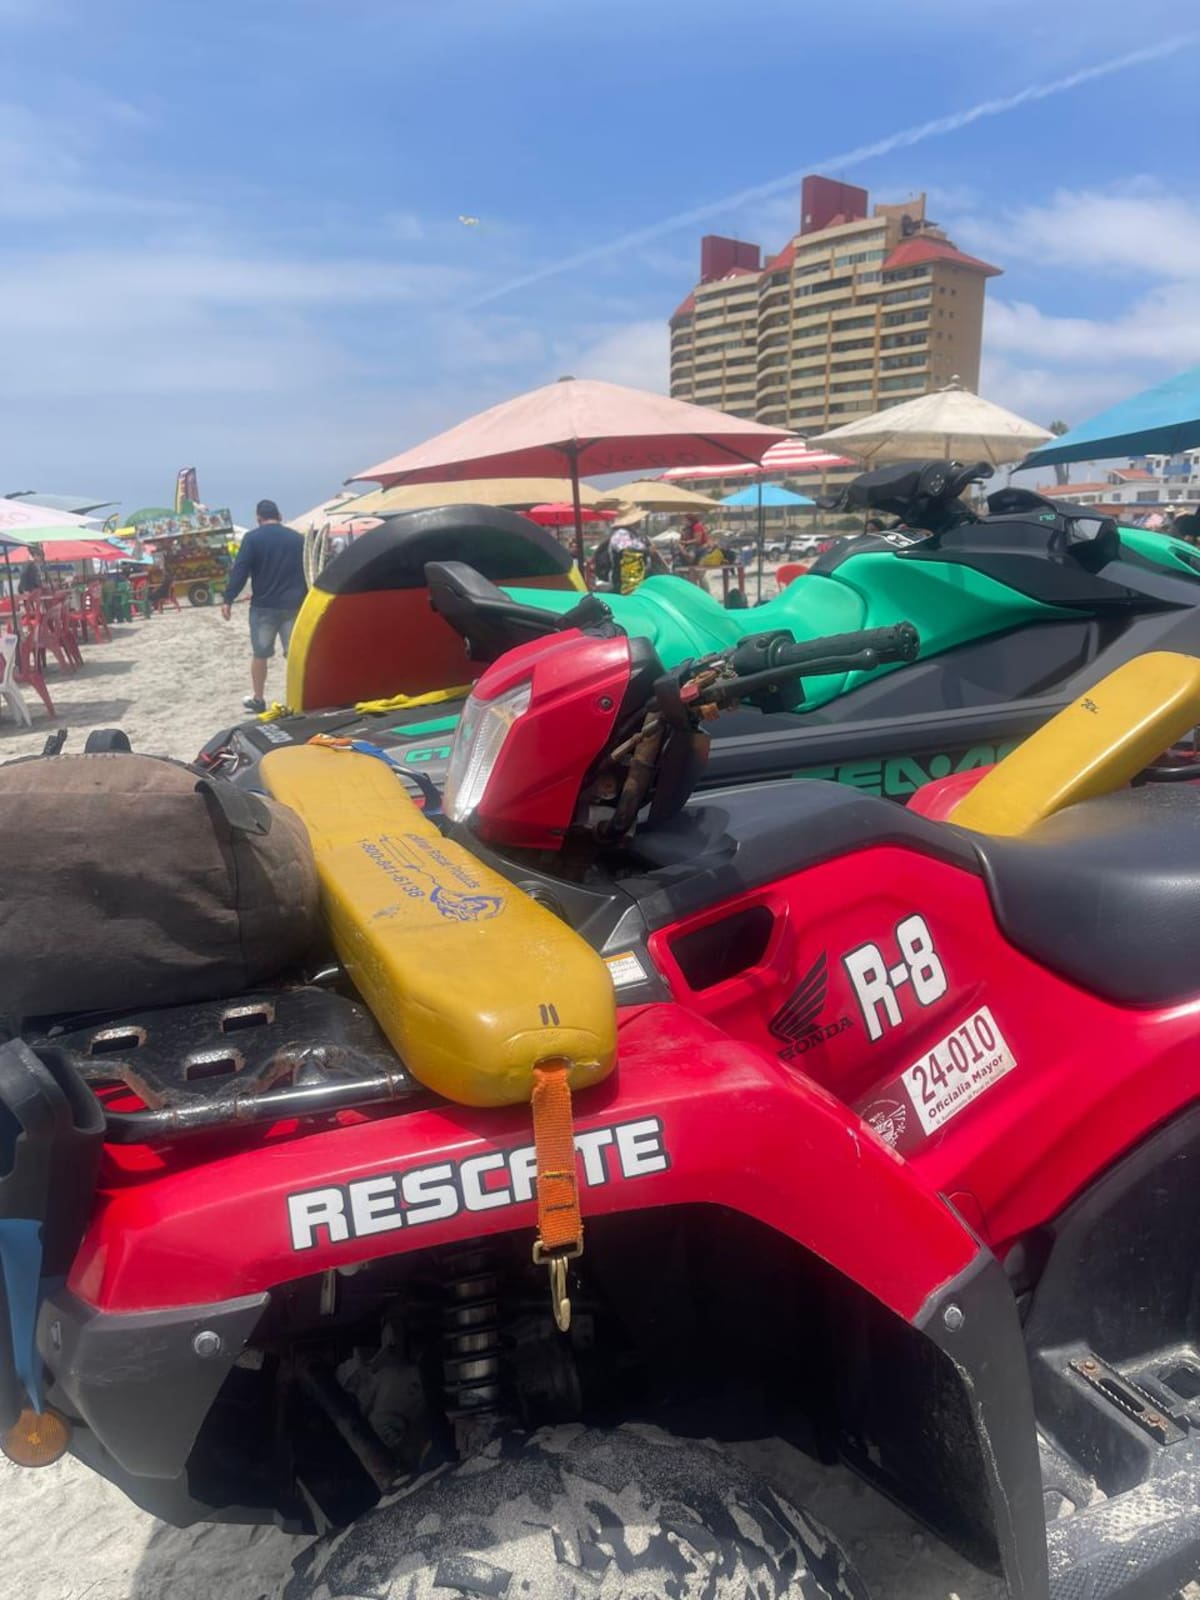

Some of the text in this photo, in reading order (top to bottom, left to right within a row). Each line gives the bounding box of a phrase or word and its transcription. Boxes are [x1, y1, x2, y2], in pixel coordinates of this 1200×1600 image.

[842, 913, 949, 1042] R-8
[777, 1016, 855, 1060] HONDA
[912, 1014, 996, 1105] 24-010
[971, 1053, 1004, 1083] Mayor
